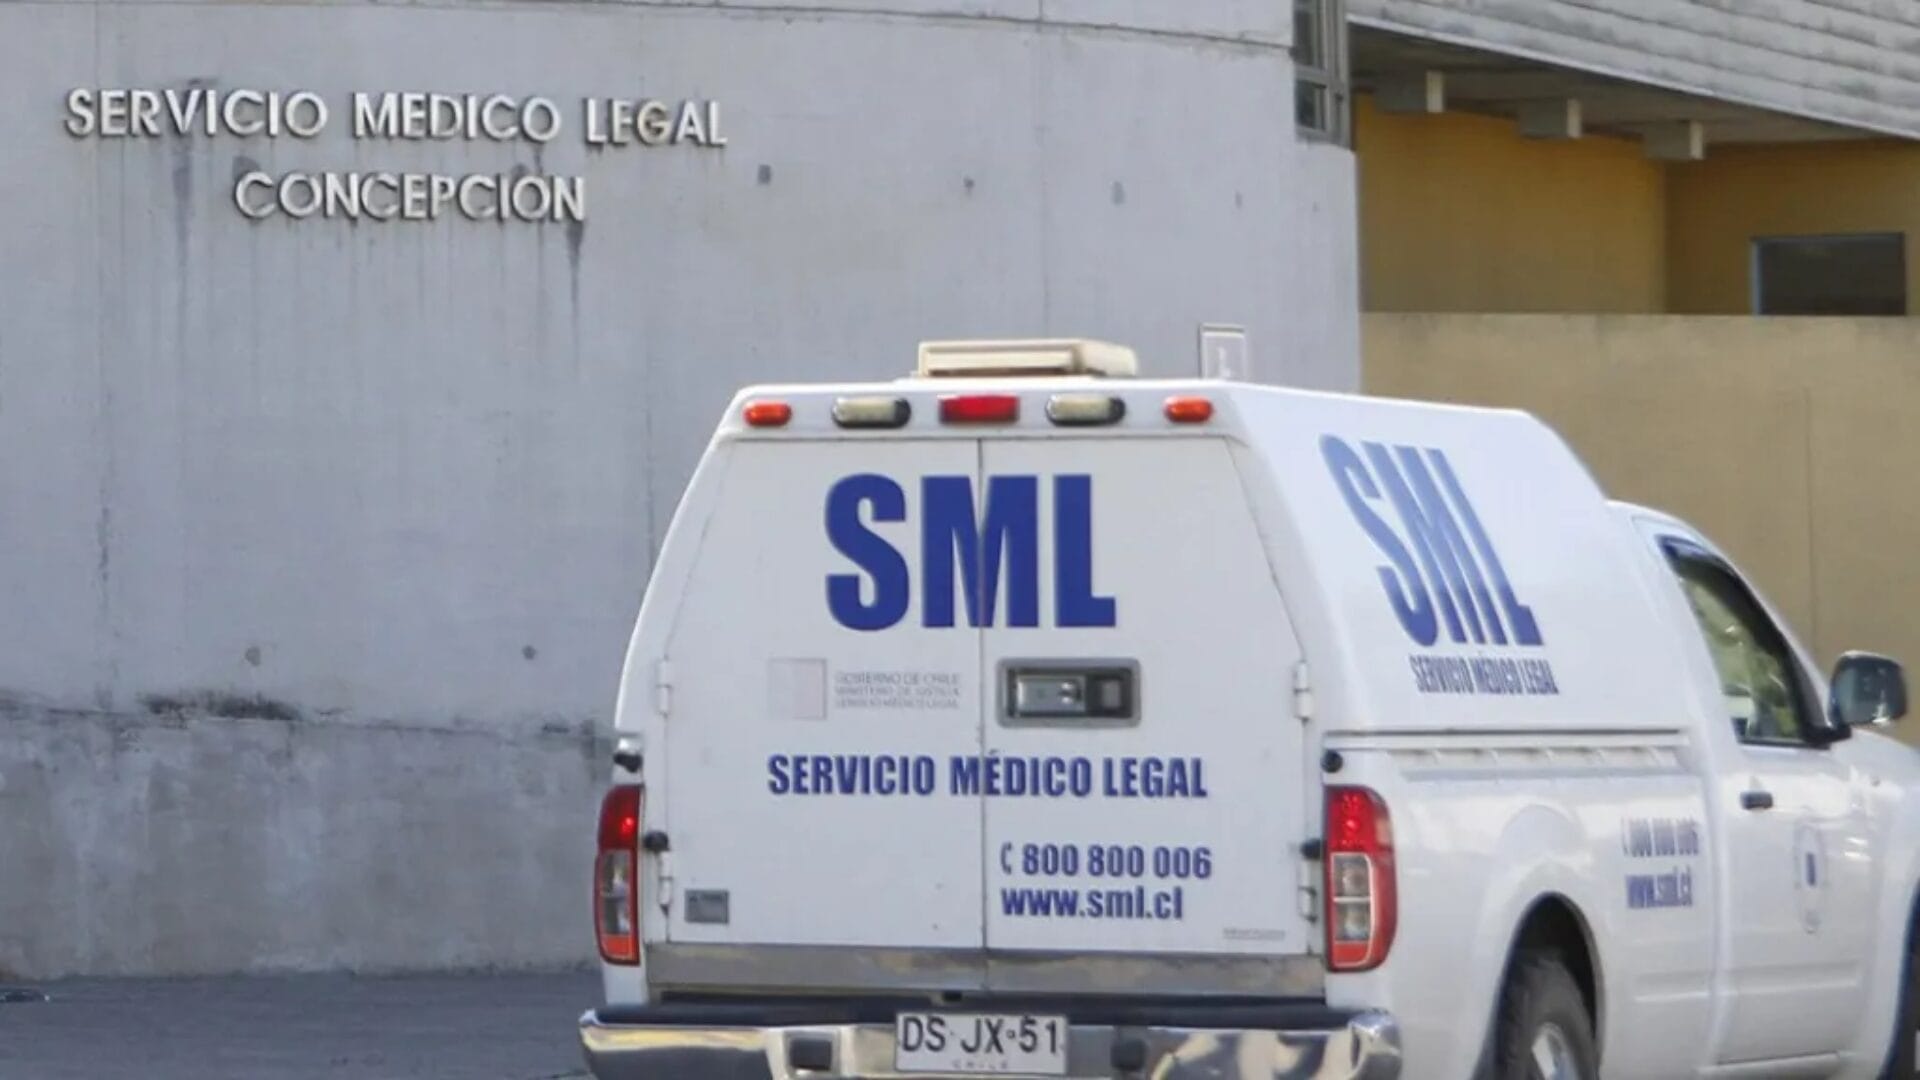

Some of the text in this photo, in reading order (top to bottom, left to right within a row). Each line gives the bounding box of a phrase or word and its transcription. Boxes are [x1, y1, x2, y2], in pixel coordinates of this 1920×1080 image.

[63, 88, 728, 147] SERVICIO MEDICO LEGAL
[824, 473, 1117, 631] SML
[1319, 434, 1544, 647] SML
[768, 748, 1208, 798] SERVICIO MÉDICO LEGAL
[1022, 844, 1212, 879] 800 800 006
[1001, 886, 1183, 919] www.sml.cl
